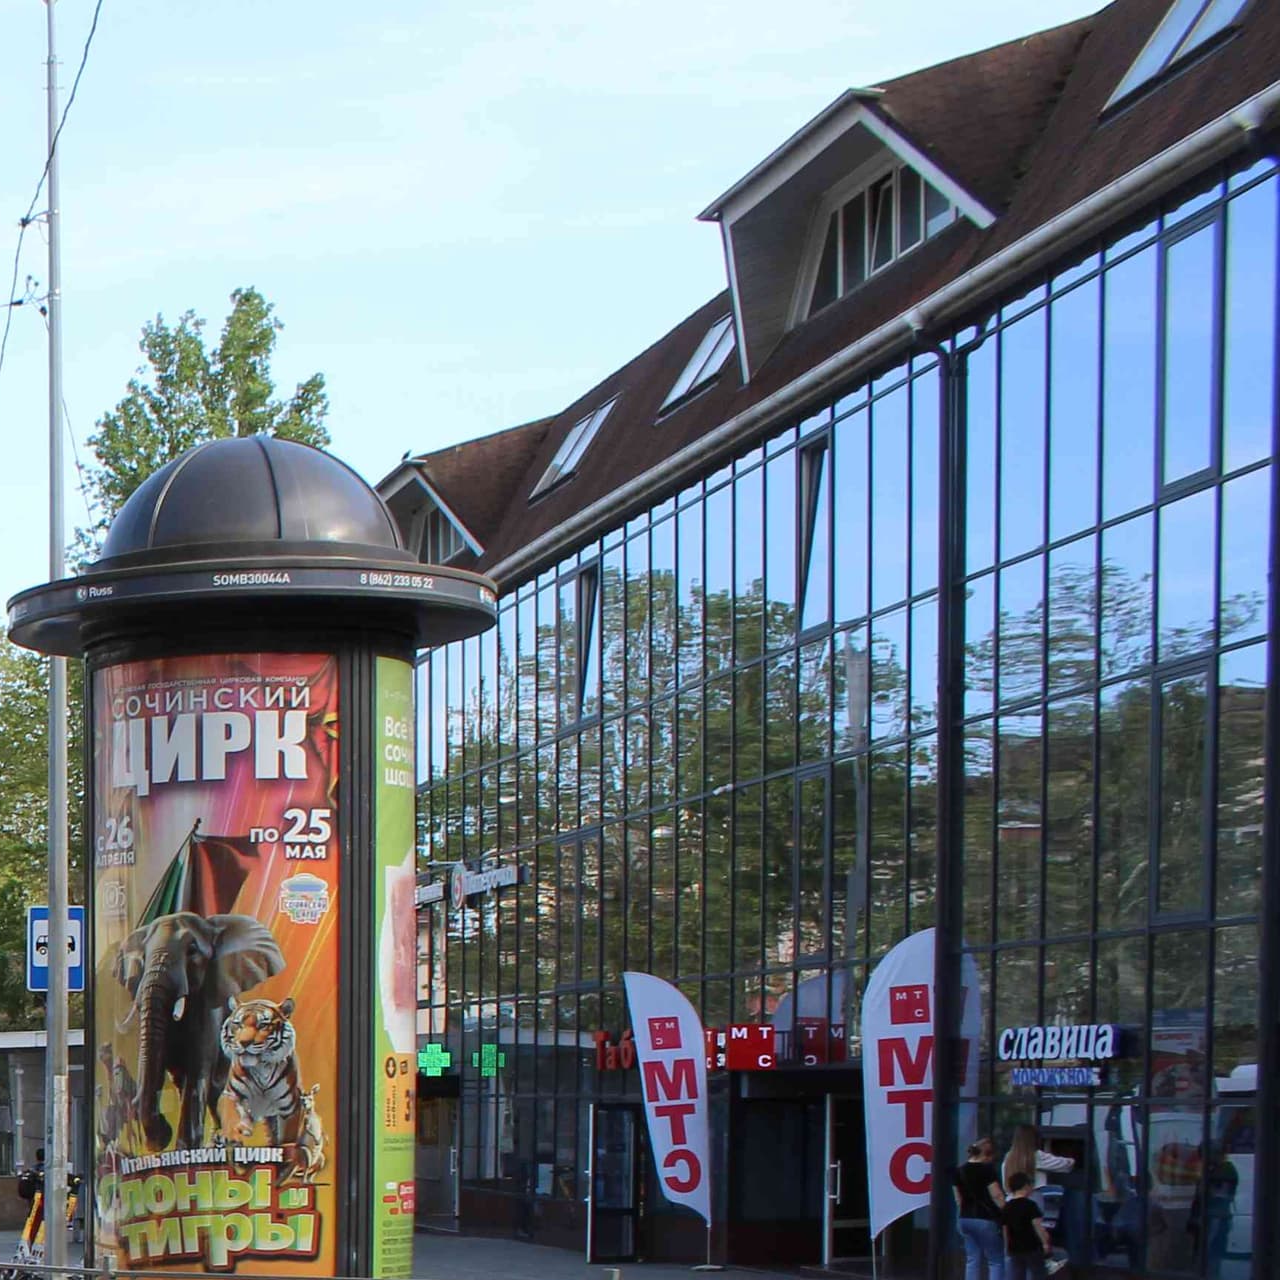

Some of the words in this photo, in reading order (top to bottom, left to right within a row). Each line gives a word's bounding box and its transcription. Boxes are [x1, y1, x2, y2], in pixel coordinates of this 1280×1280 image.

[89, 586, 113, 598] Russ
[212, 572, 290, 586] SOMB30044A
[360, 573, 367, 584] 8
[369, 573, 392, 586] (862)
[393, 574, 410, 587] 233
[411, 576, 422, 588] 05
[422, 577, 433, 589] 22
[112, 678, 310, 719] СОЧИНСКИЙ
[112, 710, 309, 797] ЦИРК
[105, 815, 134, 850] 26
[283, 808, 332, 844] 25
[96, 851, 135, 866] АПРЕЛЯ
[285, 845, 327, 859] МАЯ
[593, 1027, 636, 1072] Таб
[877, 1035, 935, 1195] МТС
